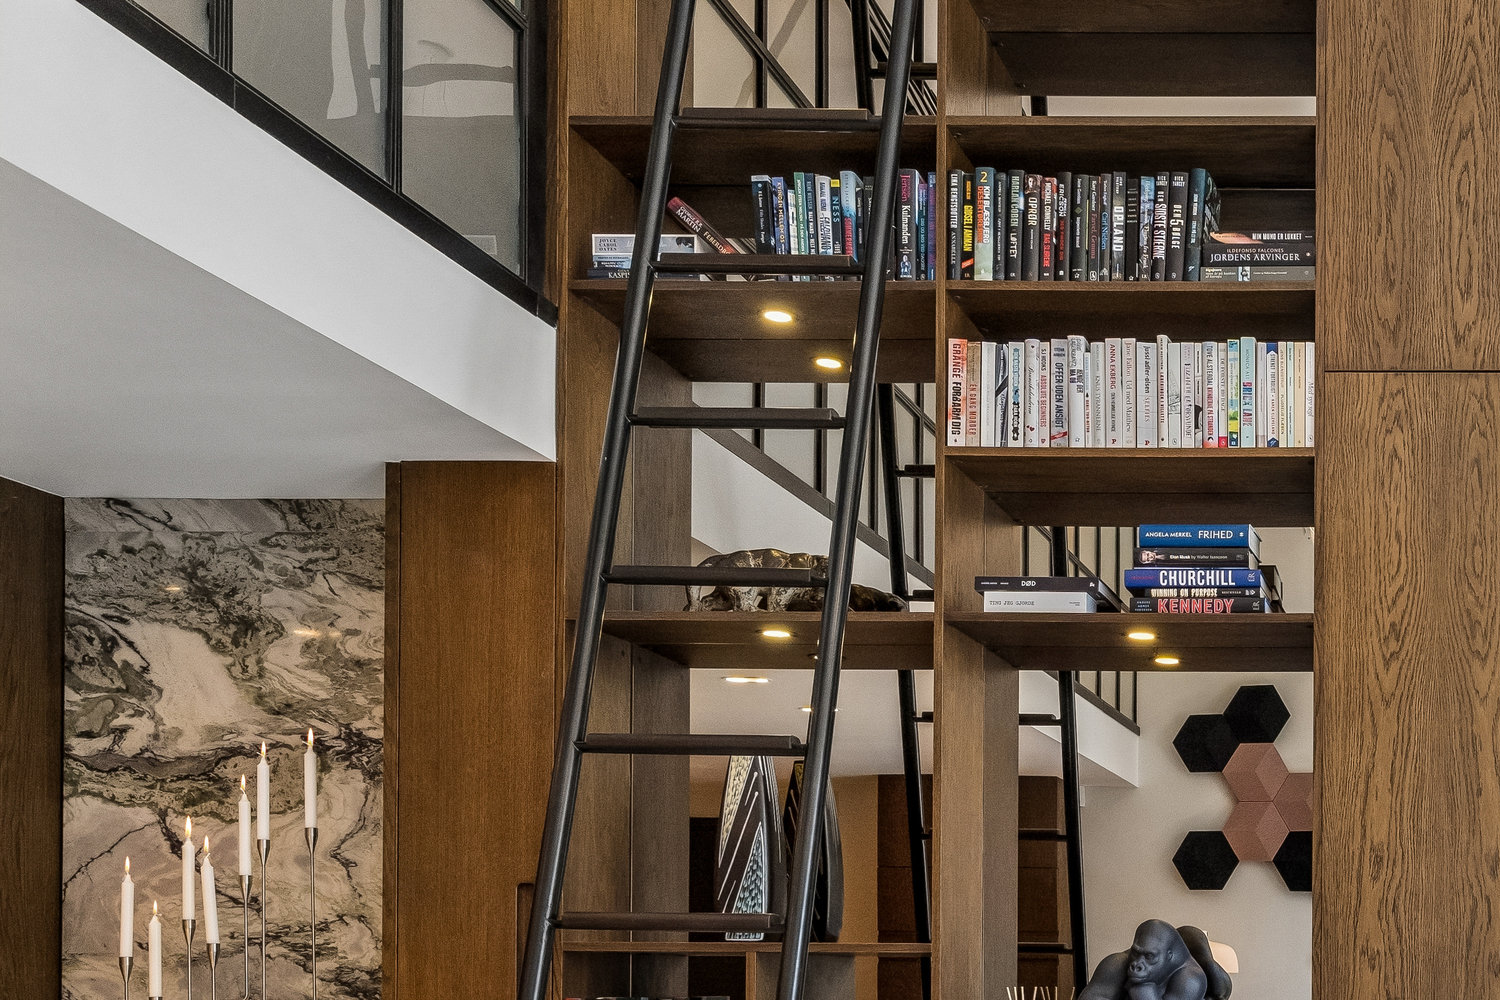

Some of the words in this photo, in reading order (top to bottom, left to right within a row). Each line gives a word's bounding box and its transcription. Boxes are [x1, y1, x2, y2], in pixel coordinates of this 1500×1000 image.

[983, 186, 991, 200] KIM
[1010, 176, 1020, 204] HARLAN
[1044, 183, 1052, 205] MICHAEL
[832, 196, 840, 223] NESS
[1010, 204, 1020, 227] COBEN
[900, 205, 912, 244] Kulmanden
[1109, 344, 1117, 364] ANNA
[1054, 362, 1064, 385] OFFER
[1109, 364, 1117, 390] EKBERG
[1054, 385, 1064, 403] UDEN
[1054, 404, 1064, 429] ANSIGT
[1198, 530, 1234, 540] FRIHED
[1159, 570, 1236, 586] CHURCHILL
[1150, 588, 1178, 598] WINNING
[1179, 588, 1189, 598] ON
[1190, 588, 1218, 598] PURPOSE
[1157, 598, 1235, 614] KENNEDY
